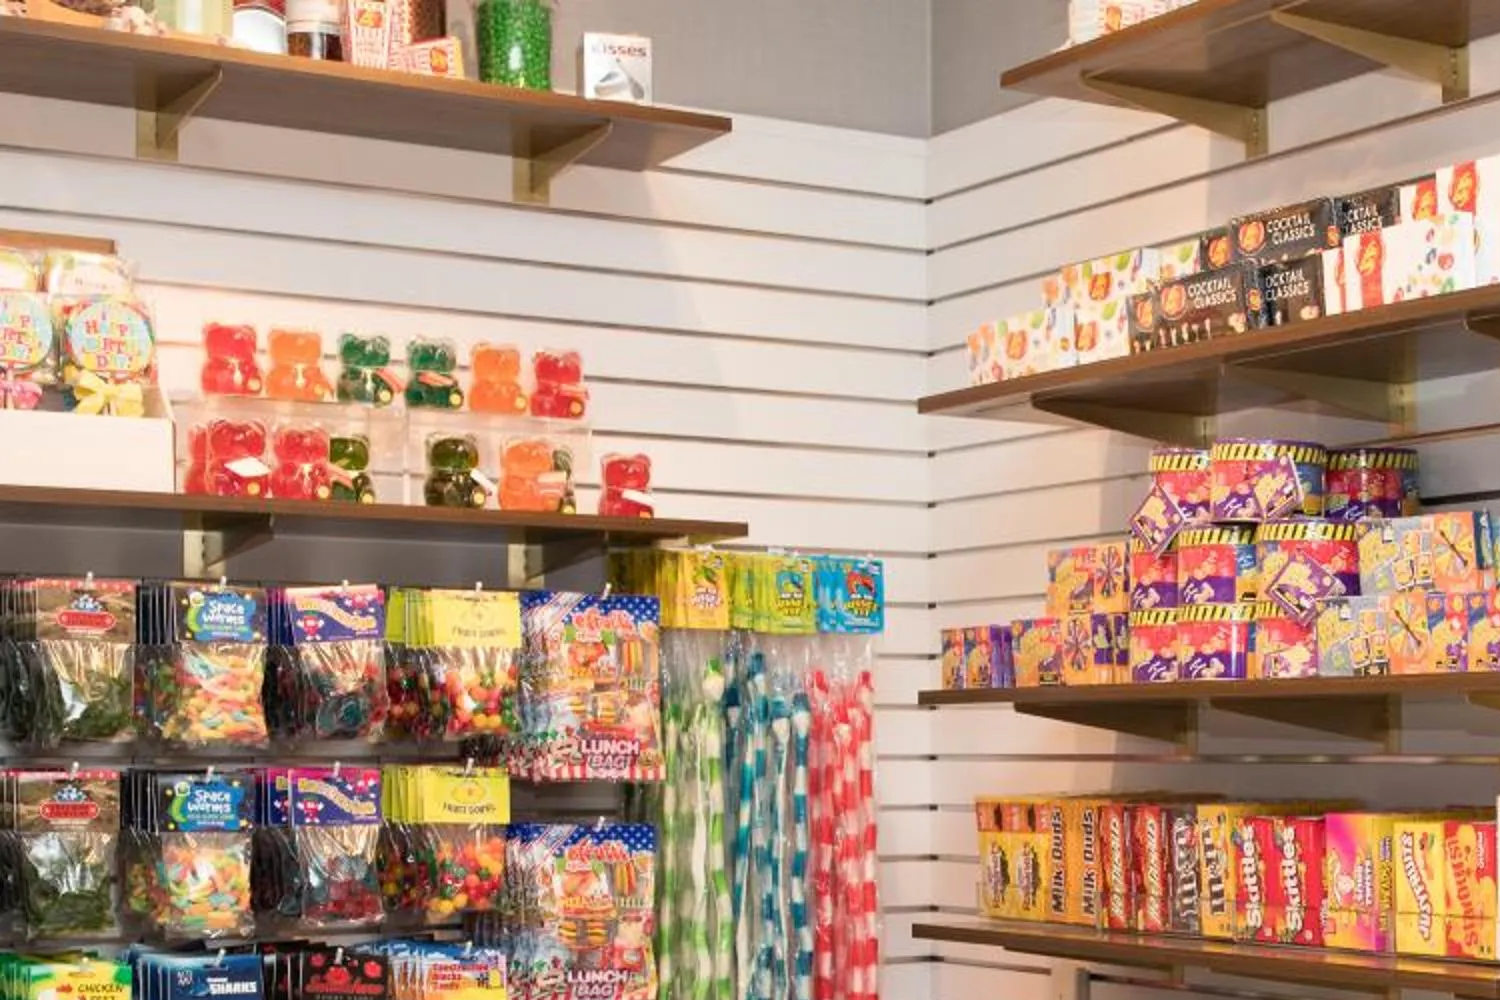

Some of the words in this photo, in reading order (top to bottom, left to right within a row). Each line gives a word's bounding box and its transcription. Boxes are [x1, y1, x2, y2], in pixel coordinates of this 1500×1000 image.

[1267, 213, 1311, 235] COCKTAIL
[1272, 223, 1316, 244] CLASSICS
[1187, 279, 1232, 300] COCKTAIL
[1193, 287, 1237, 310] CLASSICS
[581, 739, 639, 755] LUNCH
[588, 755, 626, 769] BAG
[1051, 810, 1063, 860] Duds
[1081, 810, 1094, 862] Duds
[1241, 824, 1264, 929] Skittles
[1280, 826, 1306, 932] Skittles
[1051, 871, 1064, 913] Milk
[1082, 871, 1095, 914] Milk
[567, 969, 626, 984] LUNCH
[78, 983, 123, 994] CHICKEN
[208, 980, 256, 995] SHARKS
[575, 984, 612, 998] BAG
